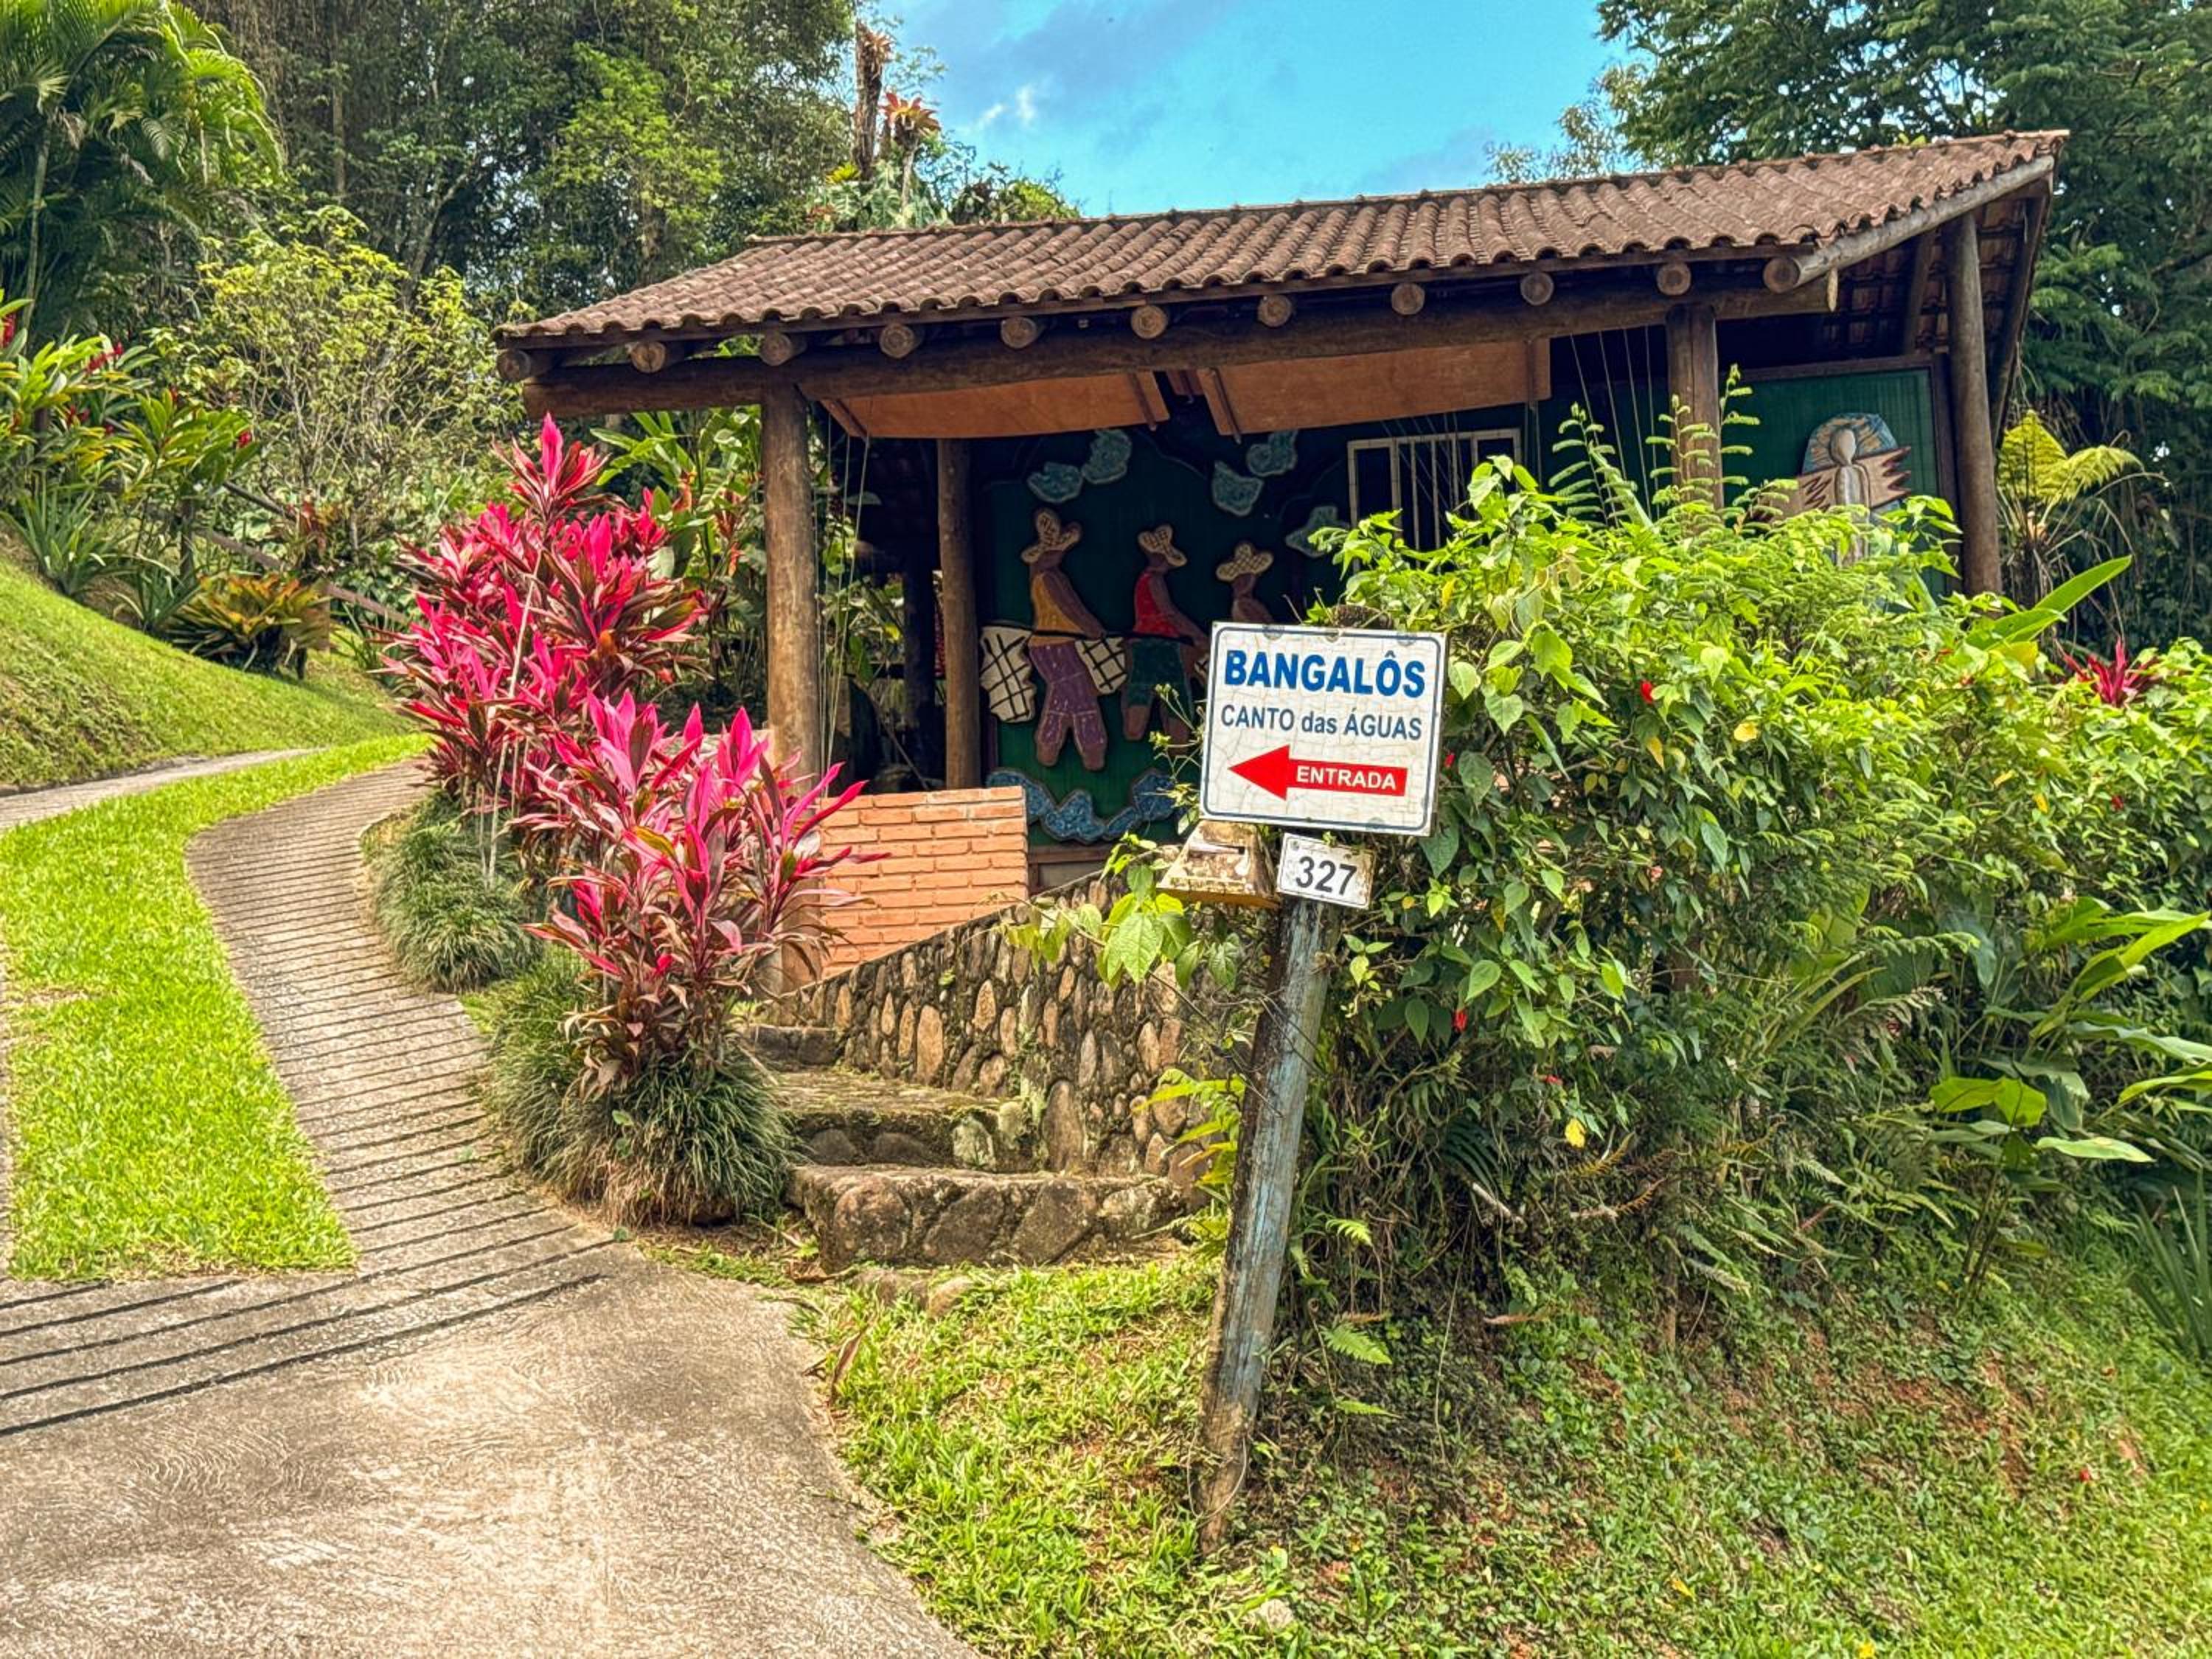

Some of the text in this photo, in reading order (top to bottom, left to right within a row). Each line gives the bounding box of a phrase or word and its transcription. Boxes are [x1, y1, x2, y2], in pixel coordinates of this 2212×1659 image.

[1225, 650, 1425, 698] BANGALÔS
[1221, 704, 1422, 740] CANTO das ÁGUAS
[1296, 765, 1397, 789] ENTRADA
[1295, 855, 1357, 895] 327
